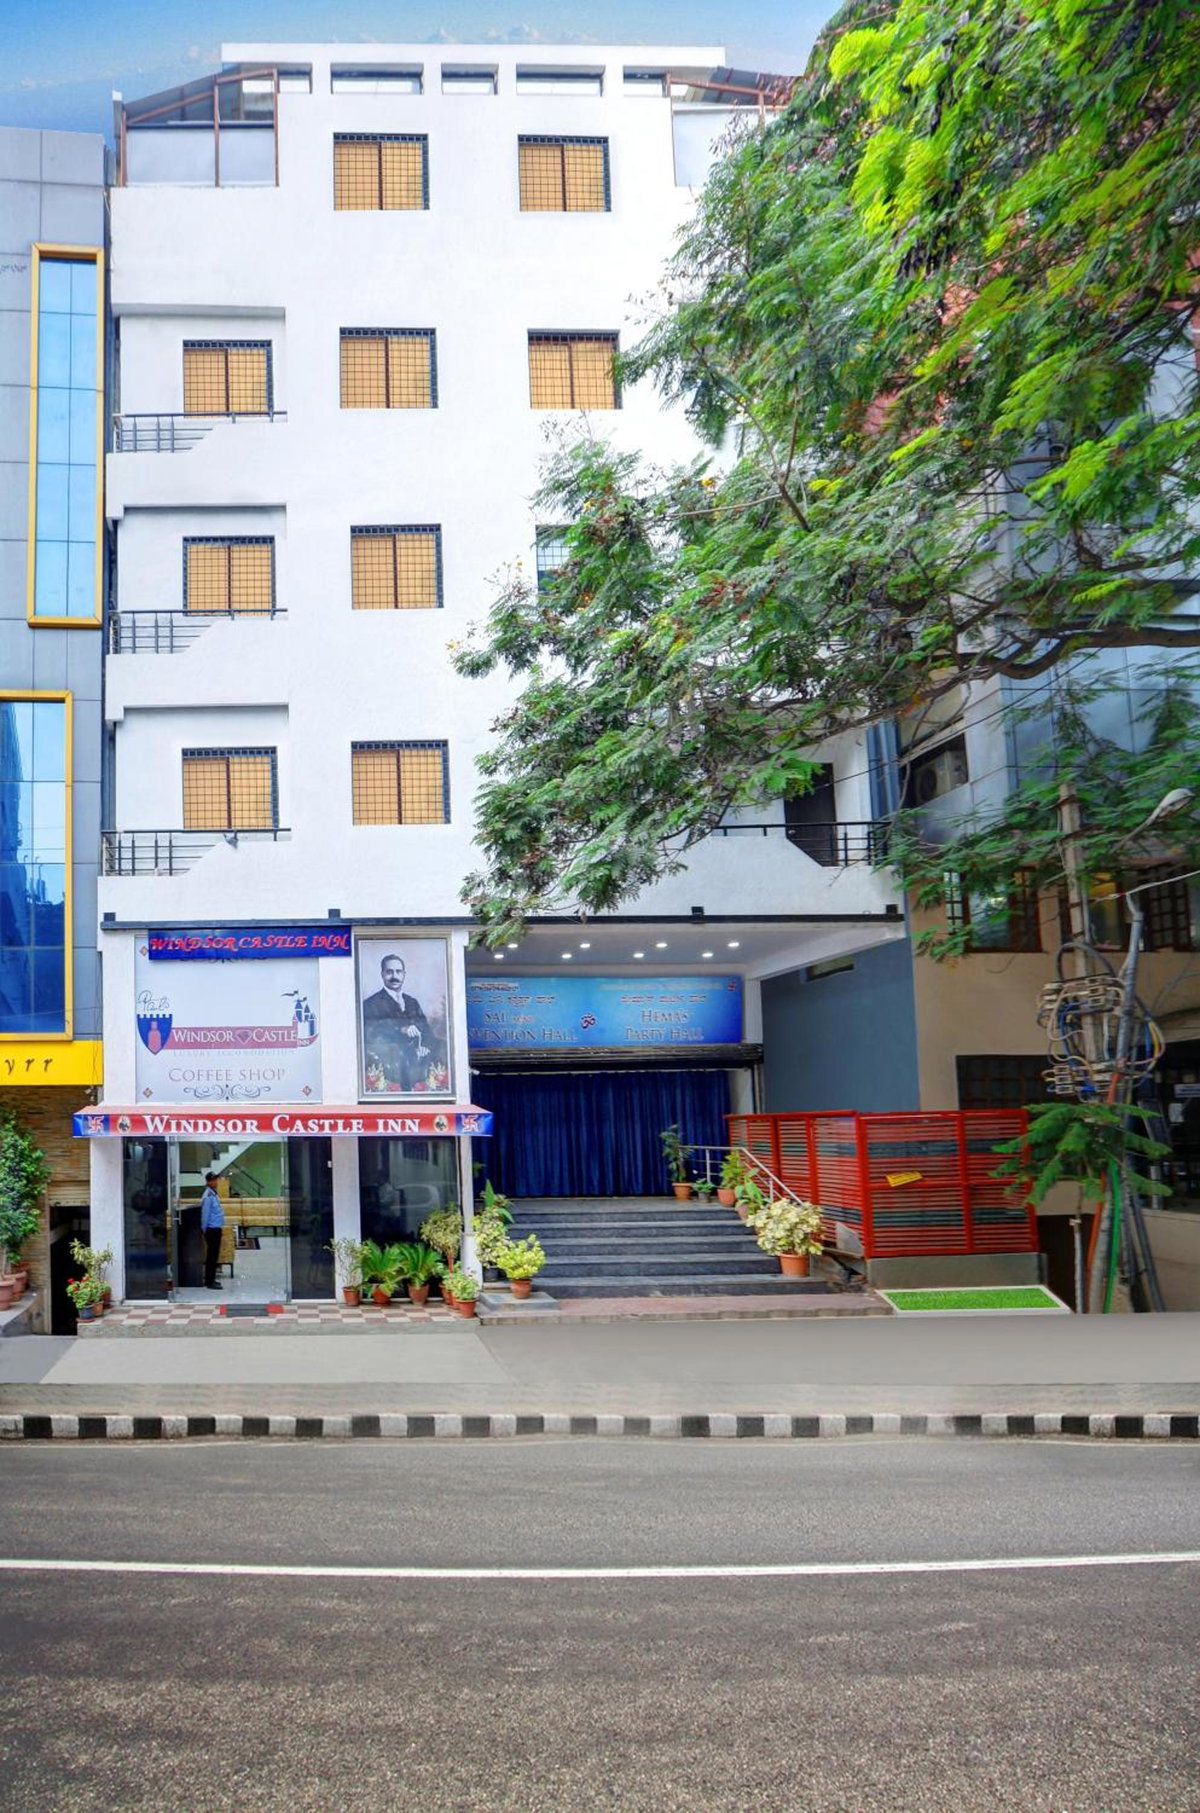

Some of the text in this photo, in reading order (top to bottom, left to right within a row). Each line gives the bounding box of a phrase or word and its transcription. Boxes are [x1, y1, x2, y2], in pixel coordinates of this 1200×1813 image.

[150, 935, 349, 951] WINDSOR CASTLE INN
[173, 1028, 297, 1043] WINDSOR CASTLE
[169, 1067, 285, 1083] COFFEE SHOP
[142, 1113, 421, 1134] WINDSOR CASTLE INN
